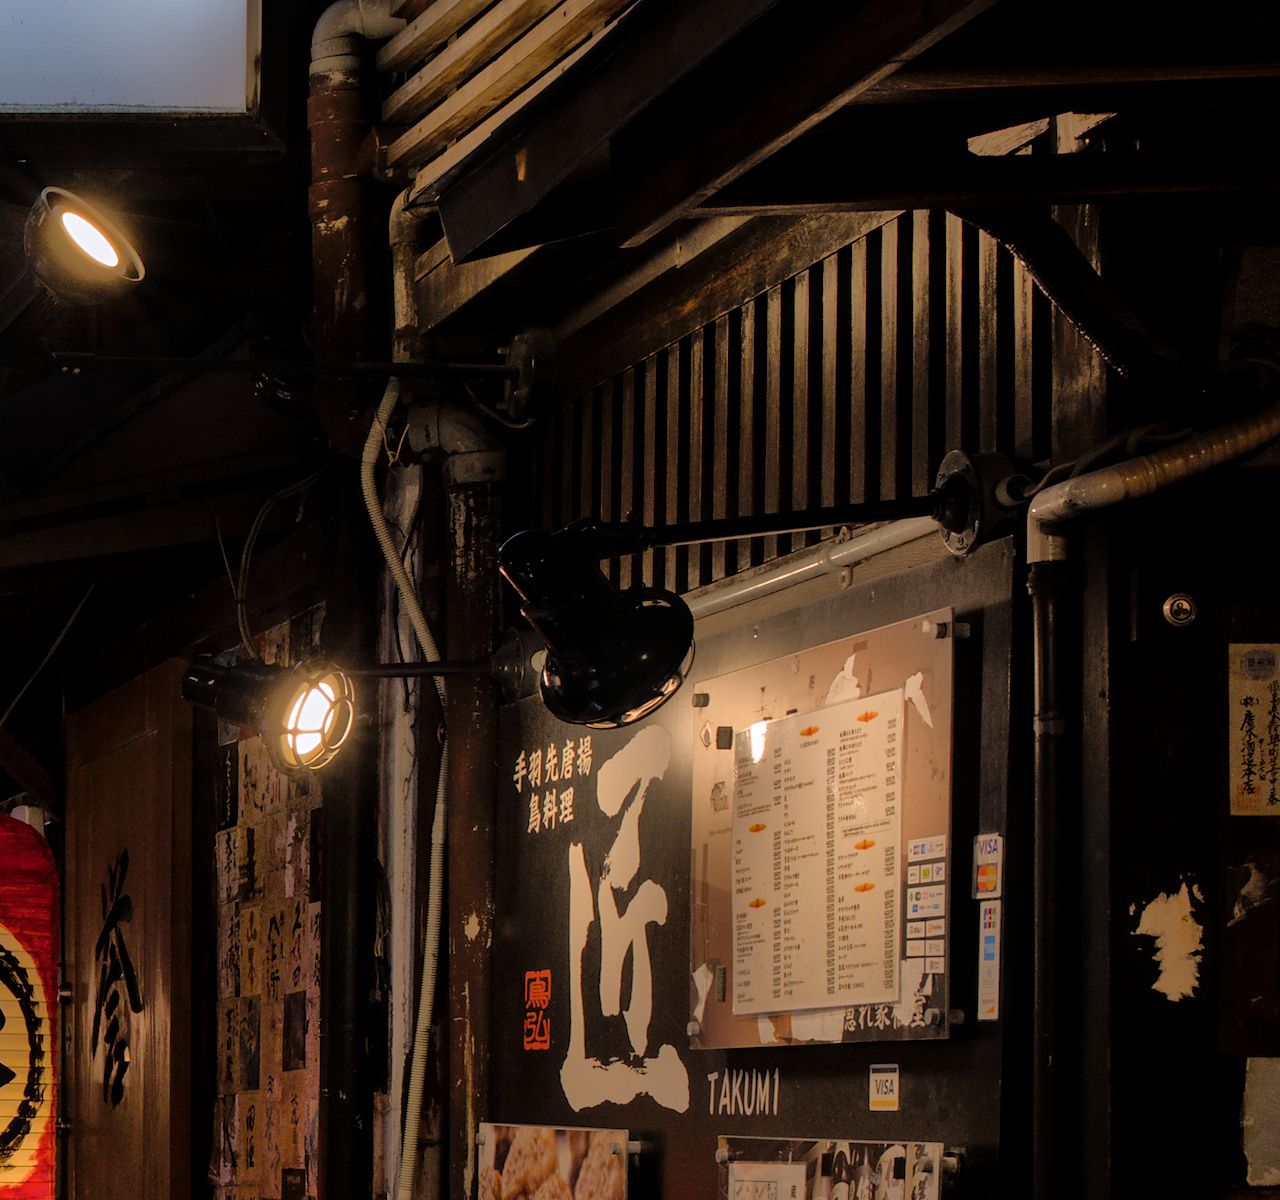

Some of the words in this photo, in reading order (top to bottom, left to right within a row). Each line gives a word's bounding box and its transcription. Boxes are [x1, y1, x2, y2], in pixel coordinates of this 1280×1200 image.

[513, 734, 593, 795] 手羽先唐揚
[526, 797, 574, 834] 鳥料理
[979, 838, 998, 856] VISA
[559, 725, 690, 1113] 匠
[707, 1067, 781, 1116] TAKUMI
[875, 1078, 895, 1096] VISA
